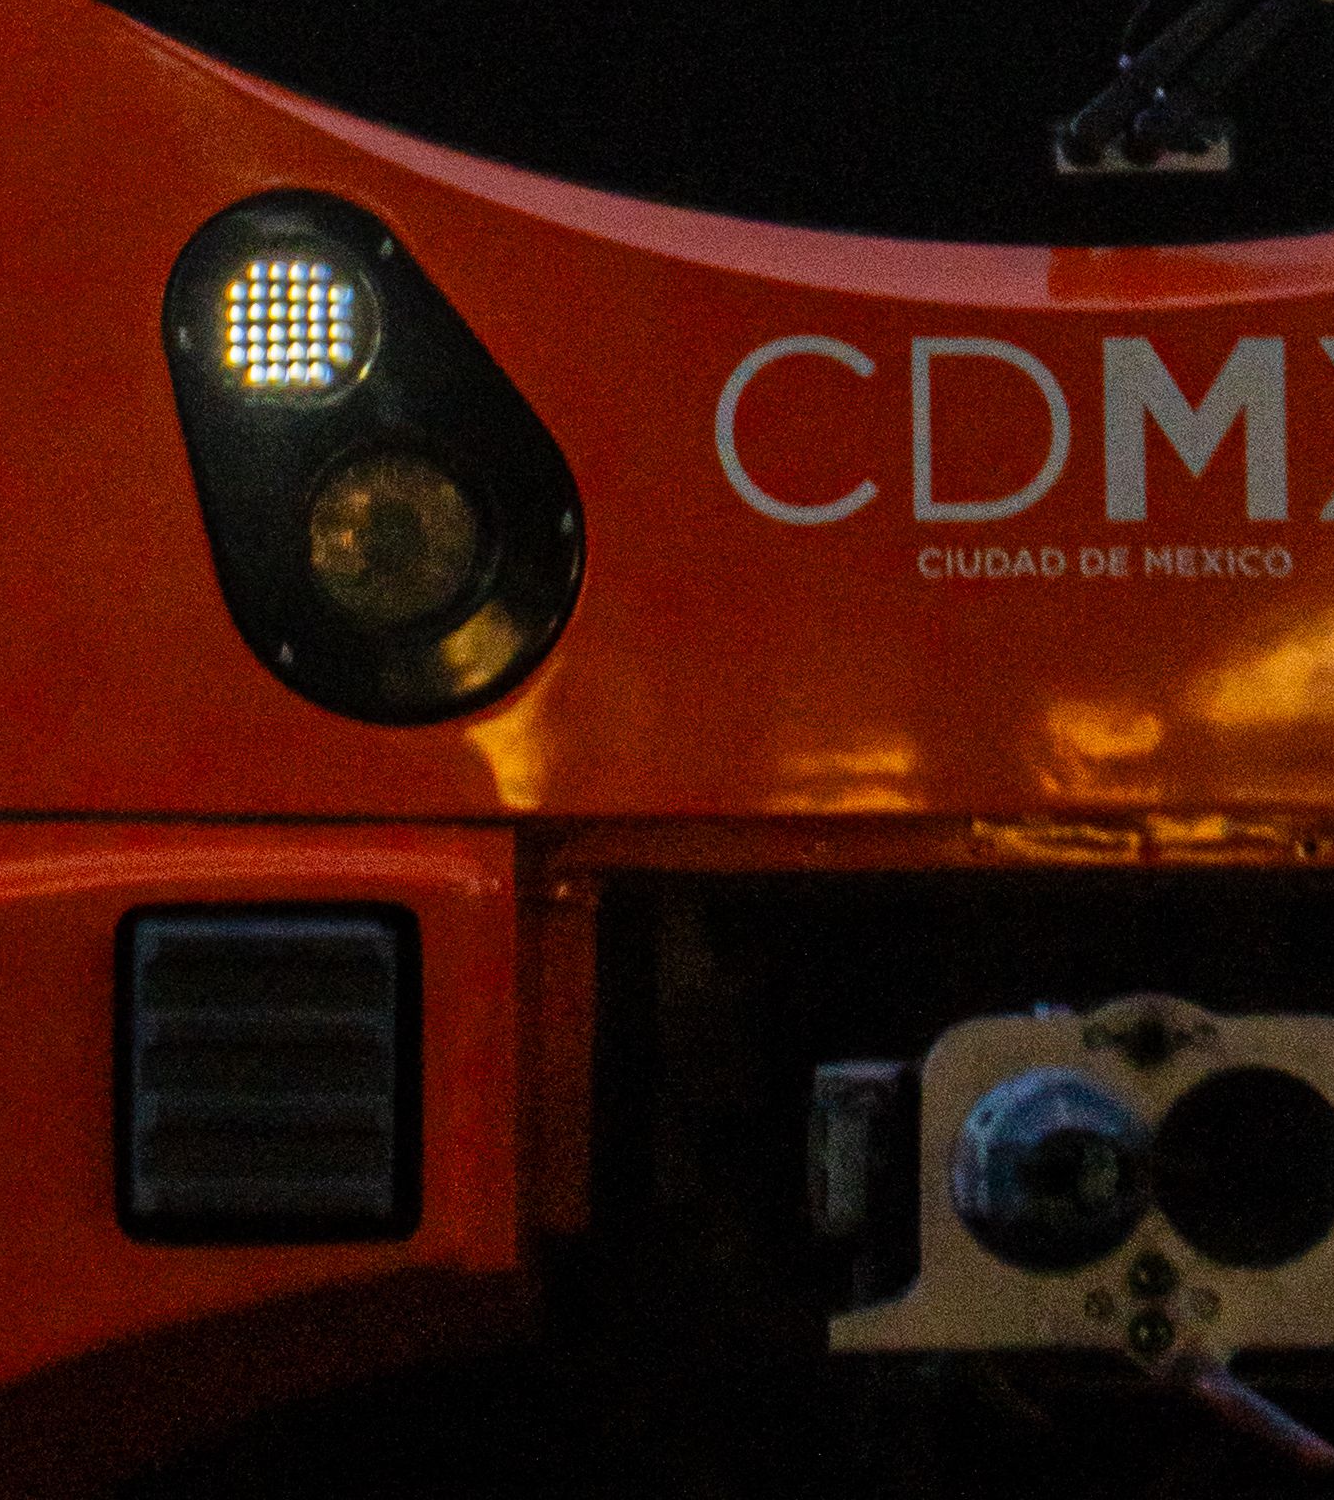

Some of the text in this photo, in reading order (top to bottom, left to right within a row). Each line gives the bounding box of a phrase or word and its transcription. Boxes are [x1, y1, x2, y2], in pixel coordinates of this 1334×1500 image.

[916, 546, 1295, 579] CIUDAD DE MEXICO
